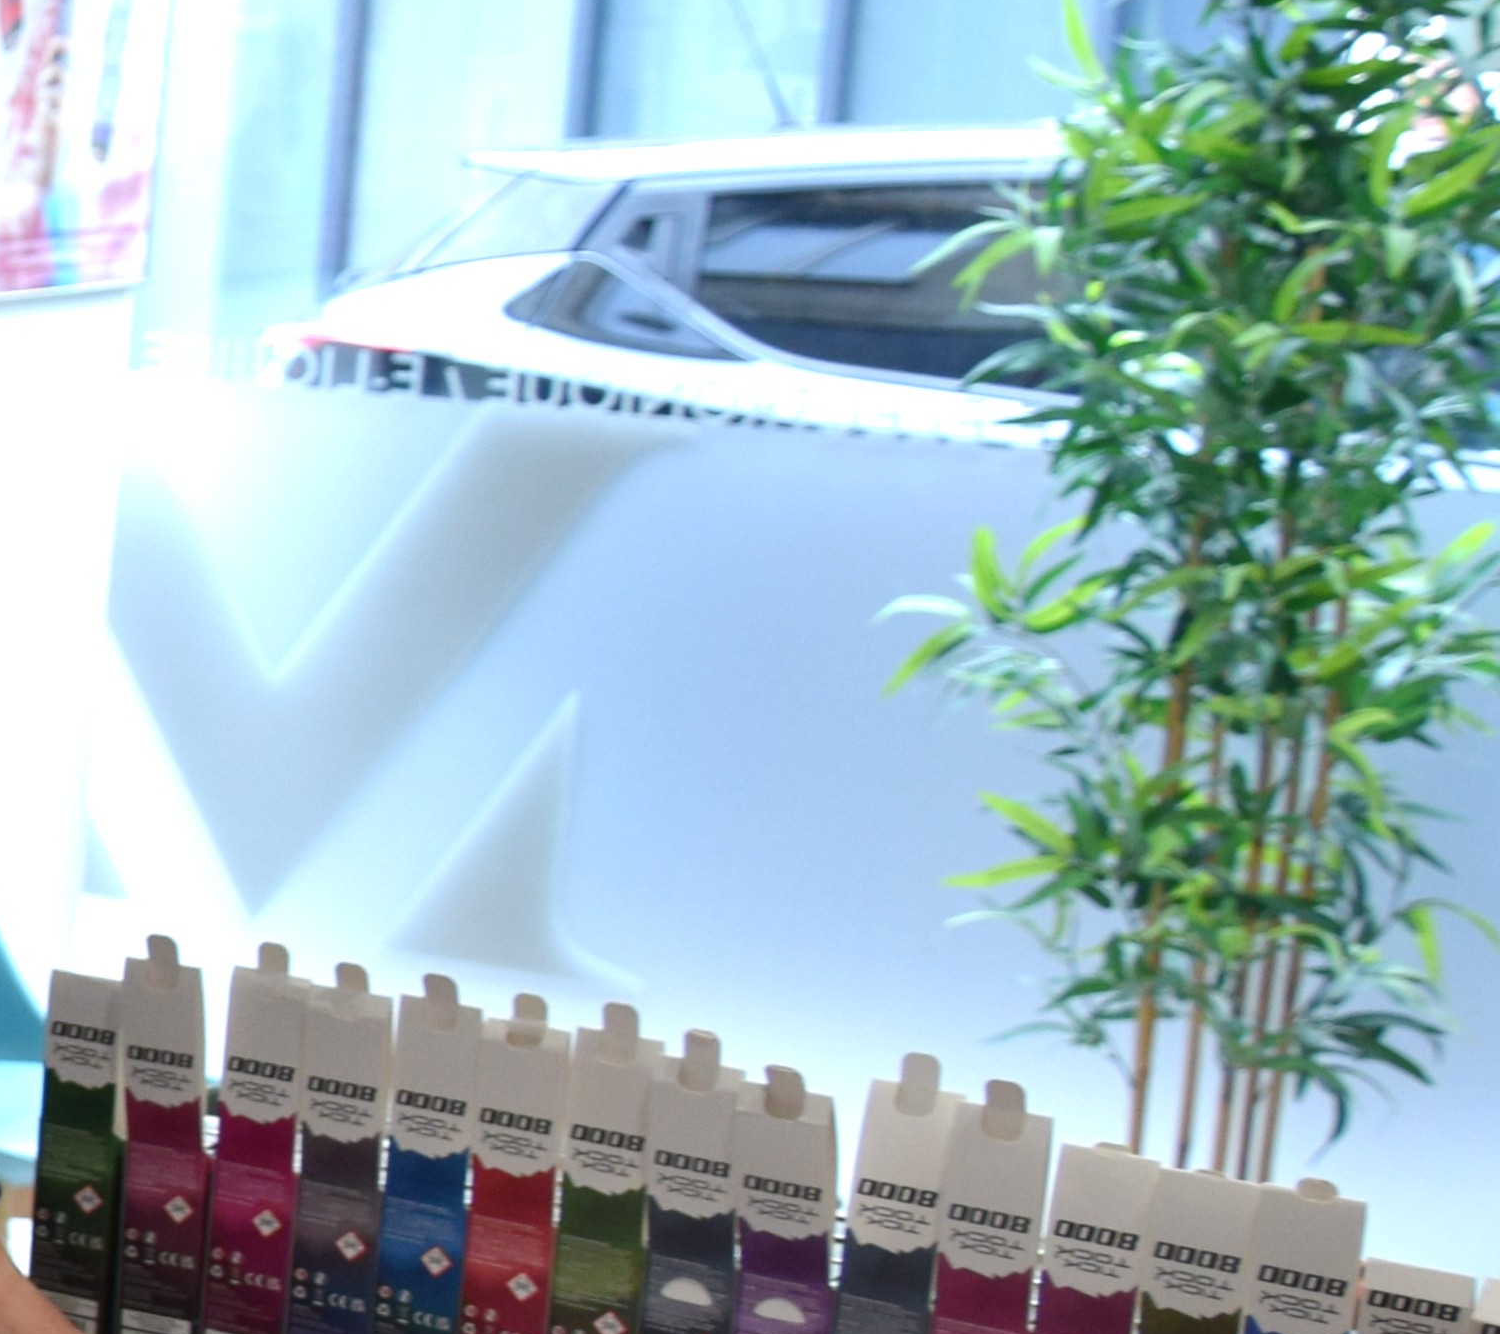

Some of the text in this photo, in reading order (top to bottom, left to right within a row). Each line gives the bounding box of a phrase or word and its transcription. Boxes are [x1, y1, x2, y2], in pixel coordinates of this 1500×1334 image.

[51, 1020, 115, 1045] 8000
[128, 1044, 193, 1068] 8000
[227, 1055, 295, 1082] 8000
[308, 1076, 377, 1102] 8000
[396, 1089, 467, 1116] 8000
[480, 1108, 552, 1135] 8000
[571, 1124, 645, 1152] 8000
[655, 1150, 730, 1177] 8000
[743, 1175, 821, 1202] 8000
[857, 1178, 939, 1208] 8000
[949, 1203, 1032, 1234] 8000
[1054, 1220, 1139, 1251] 8000
[1155, 1242, 1242, 1273] 8000
[1259, 1265, 1347, 1297] 8000
[1369, 1290, 1460, 1322] 8000
